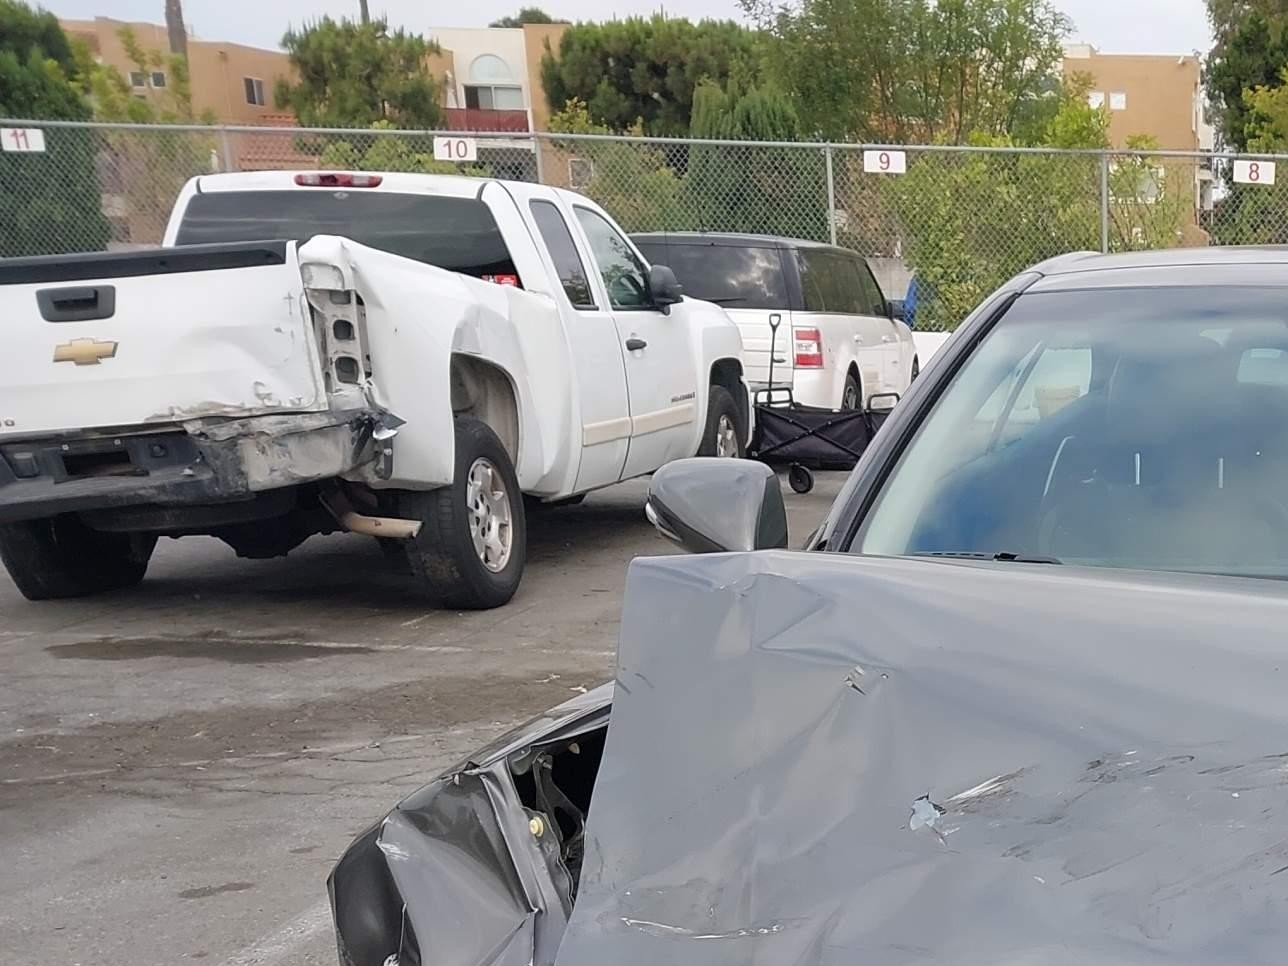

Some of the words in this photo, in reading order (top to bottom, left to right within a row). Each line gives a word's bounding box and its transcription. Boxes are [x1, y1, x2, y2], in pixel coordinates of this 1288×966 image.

[10, 129, 30, 149] 11
[443, 140, 468, 158] 10
[878, 152, 890, 171] 9
[1248, 162, 1260, 182] 8
